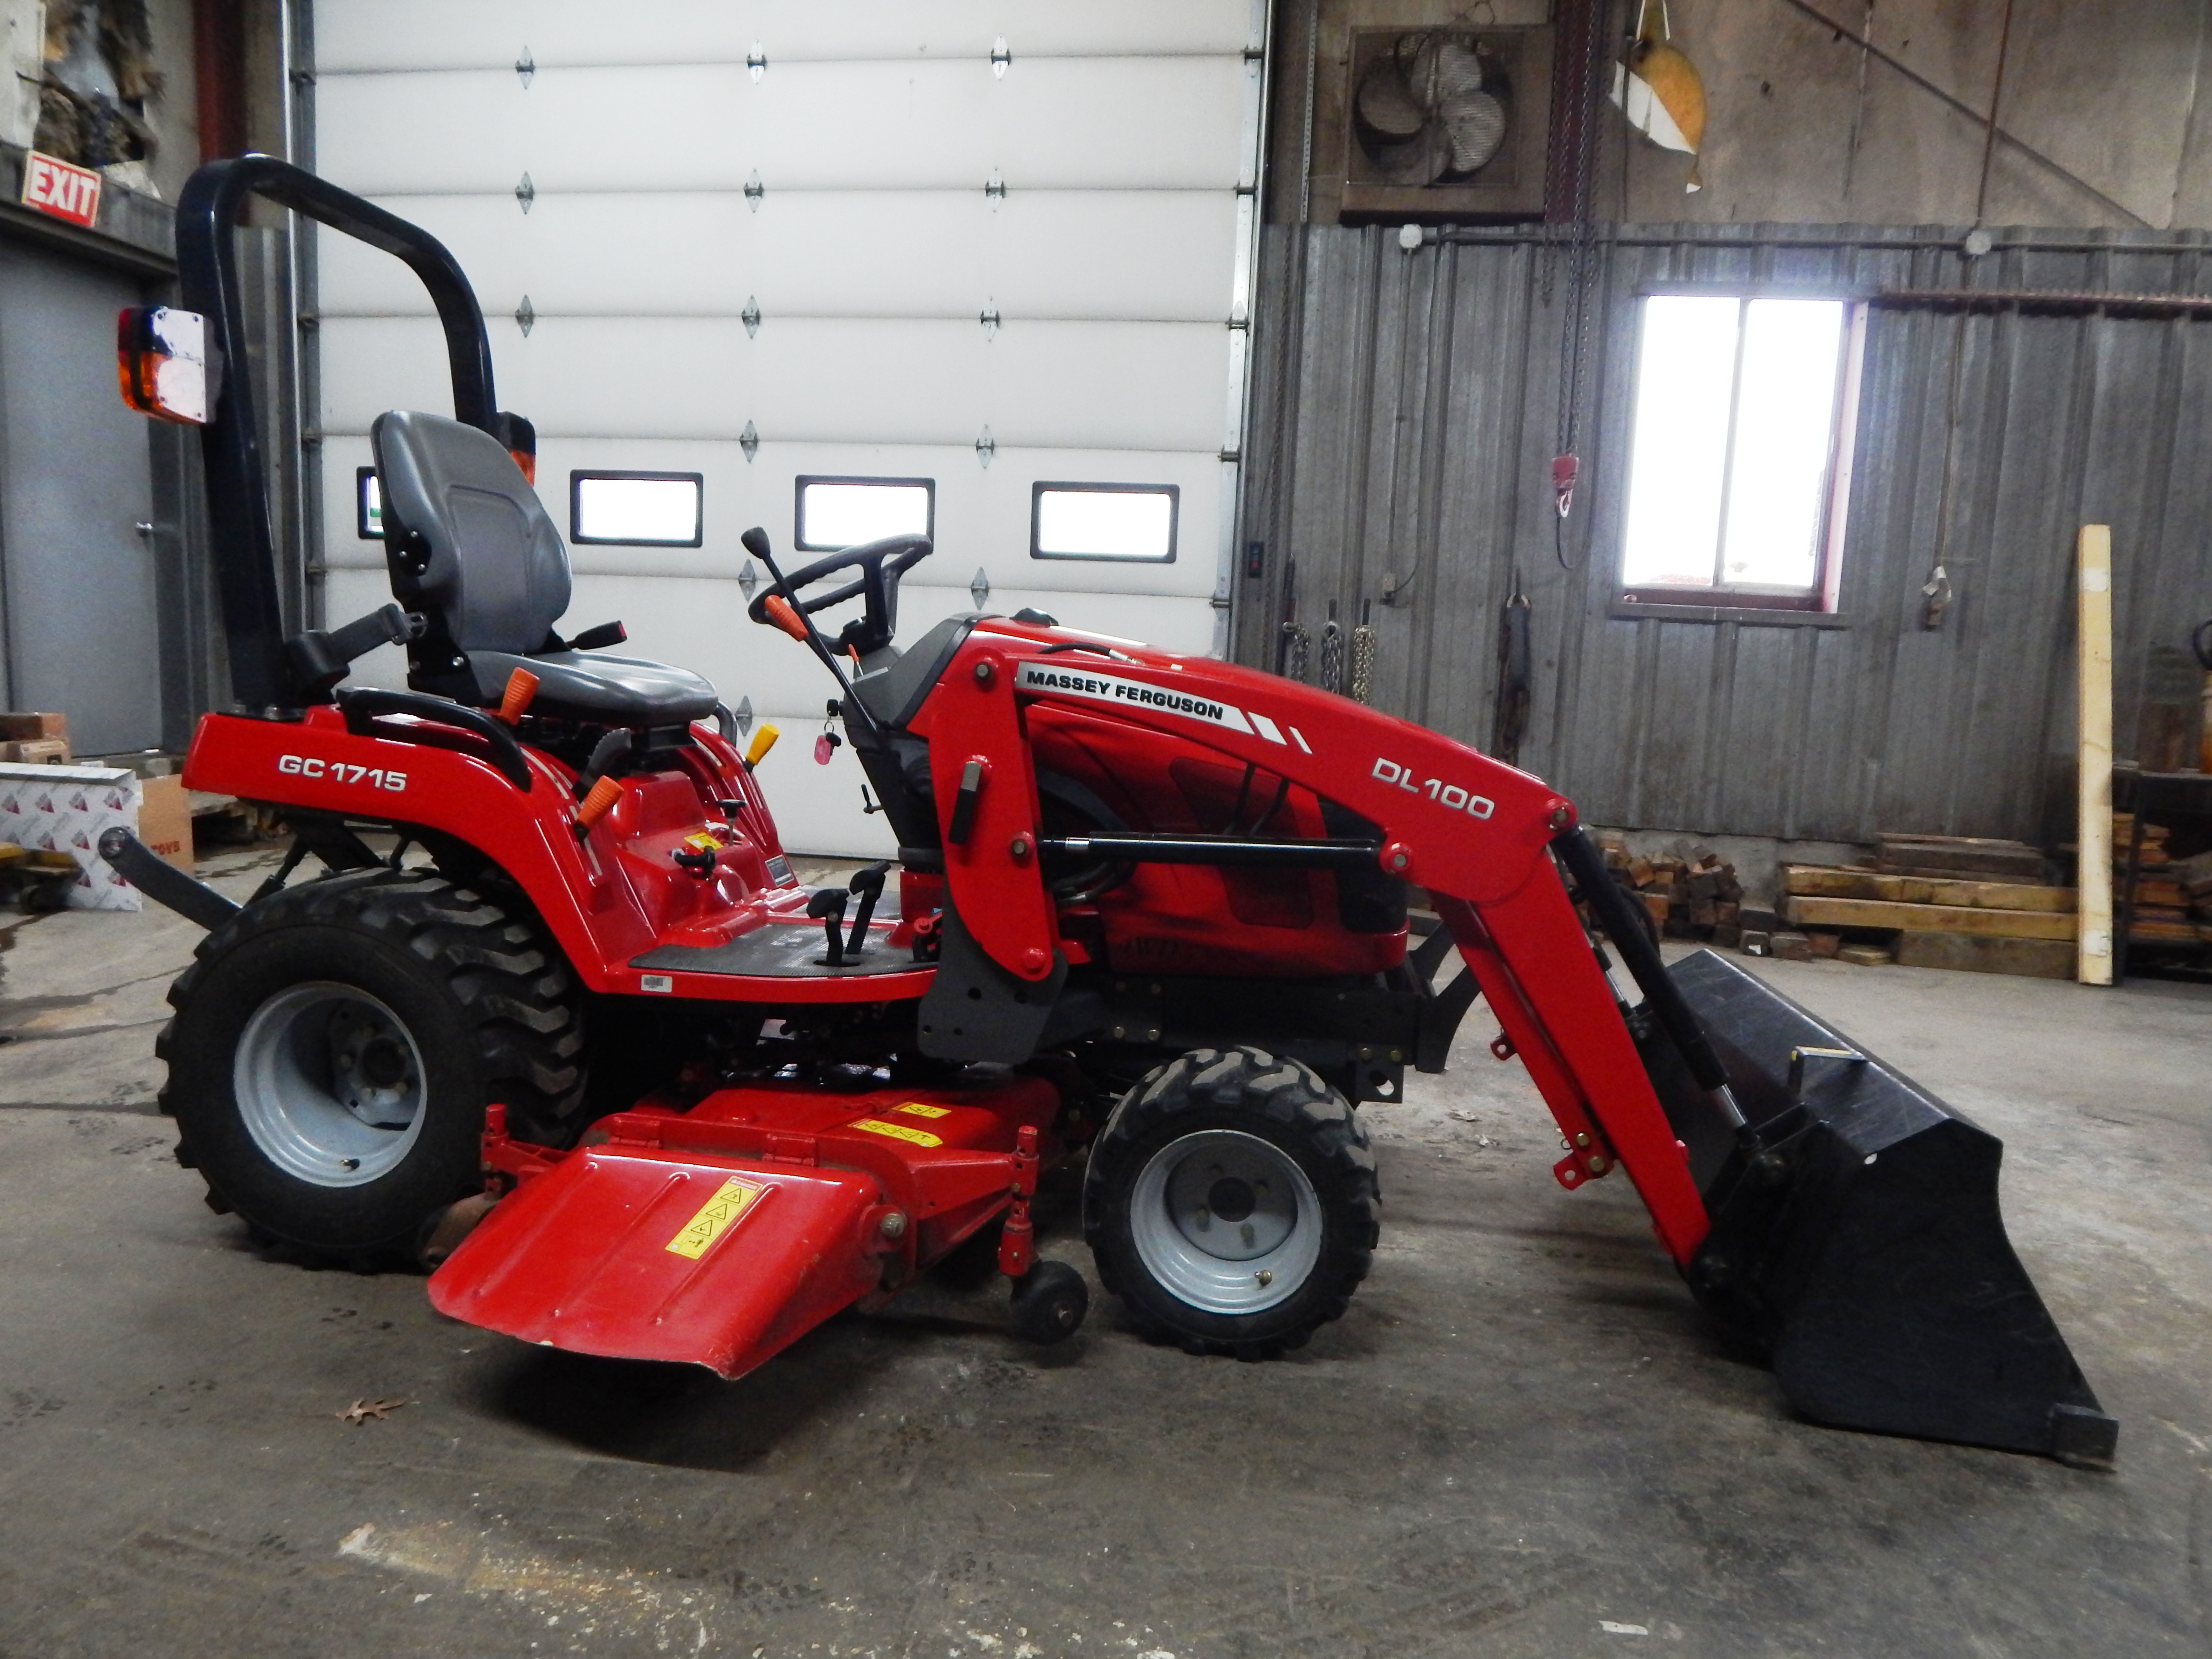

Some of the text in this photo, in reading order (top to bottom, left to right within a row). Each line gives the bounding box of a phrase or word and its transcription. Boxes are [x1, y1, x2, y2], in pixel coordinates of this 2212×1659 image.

[29, 159, 95, 216] EXIT
[1026, 671, 1224, 721] MASSEY FERGUSON
